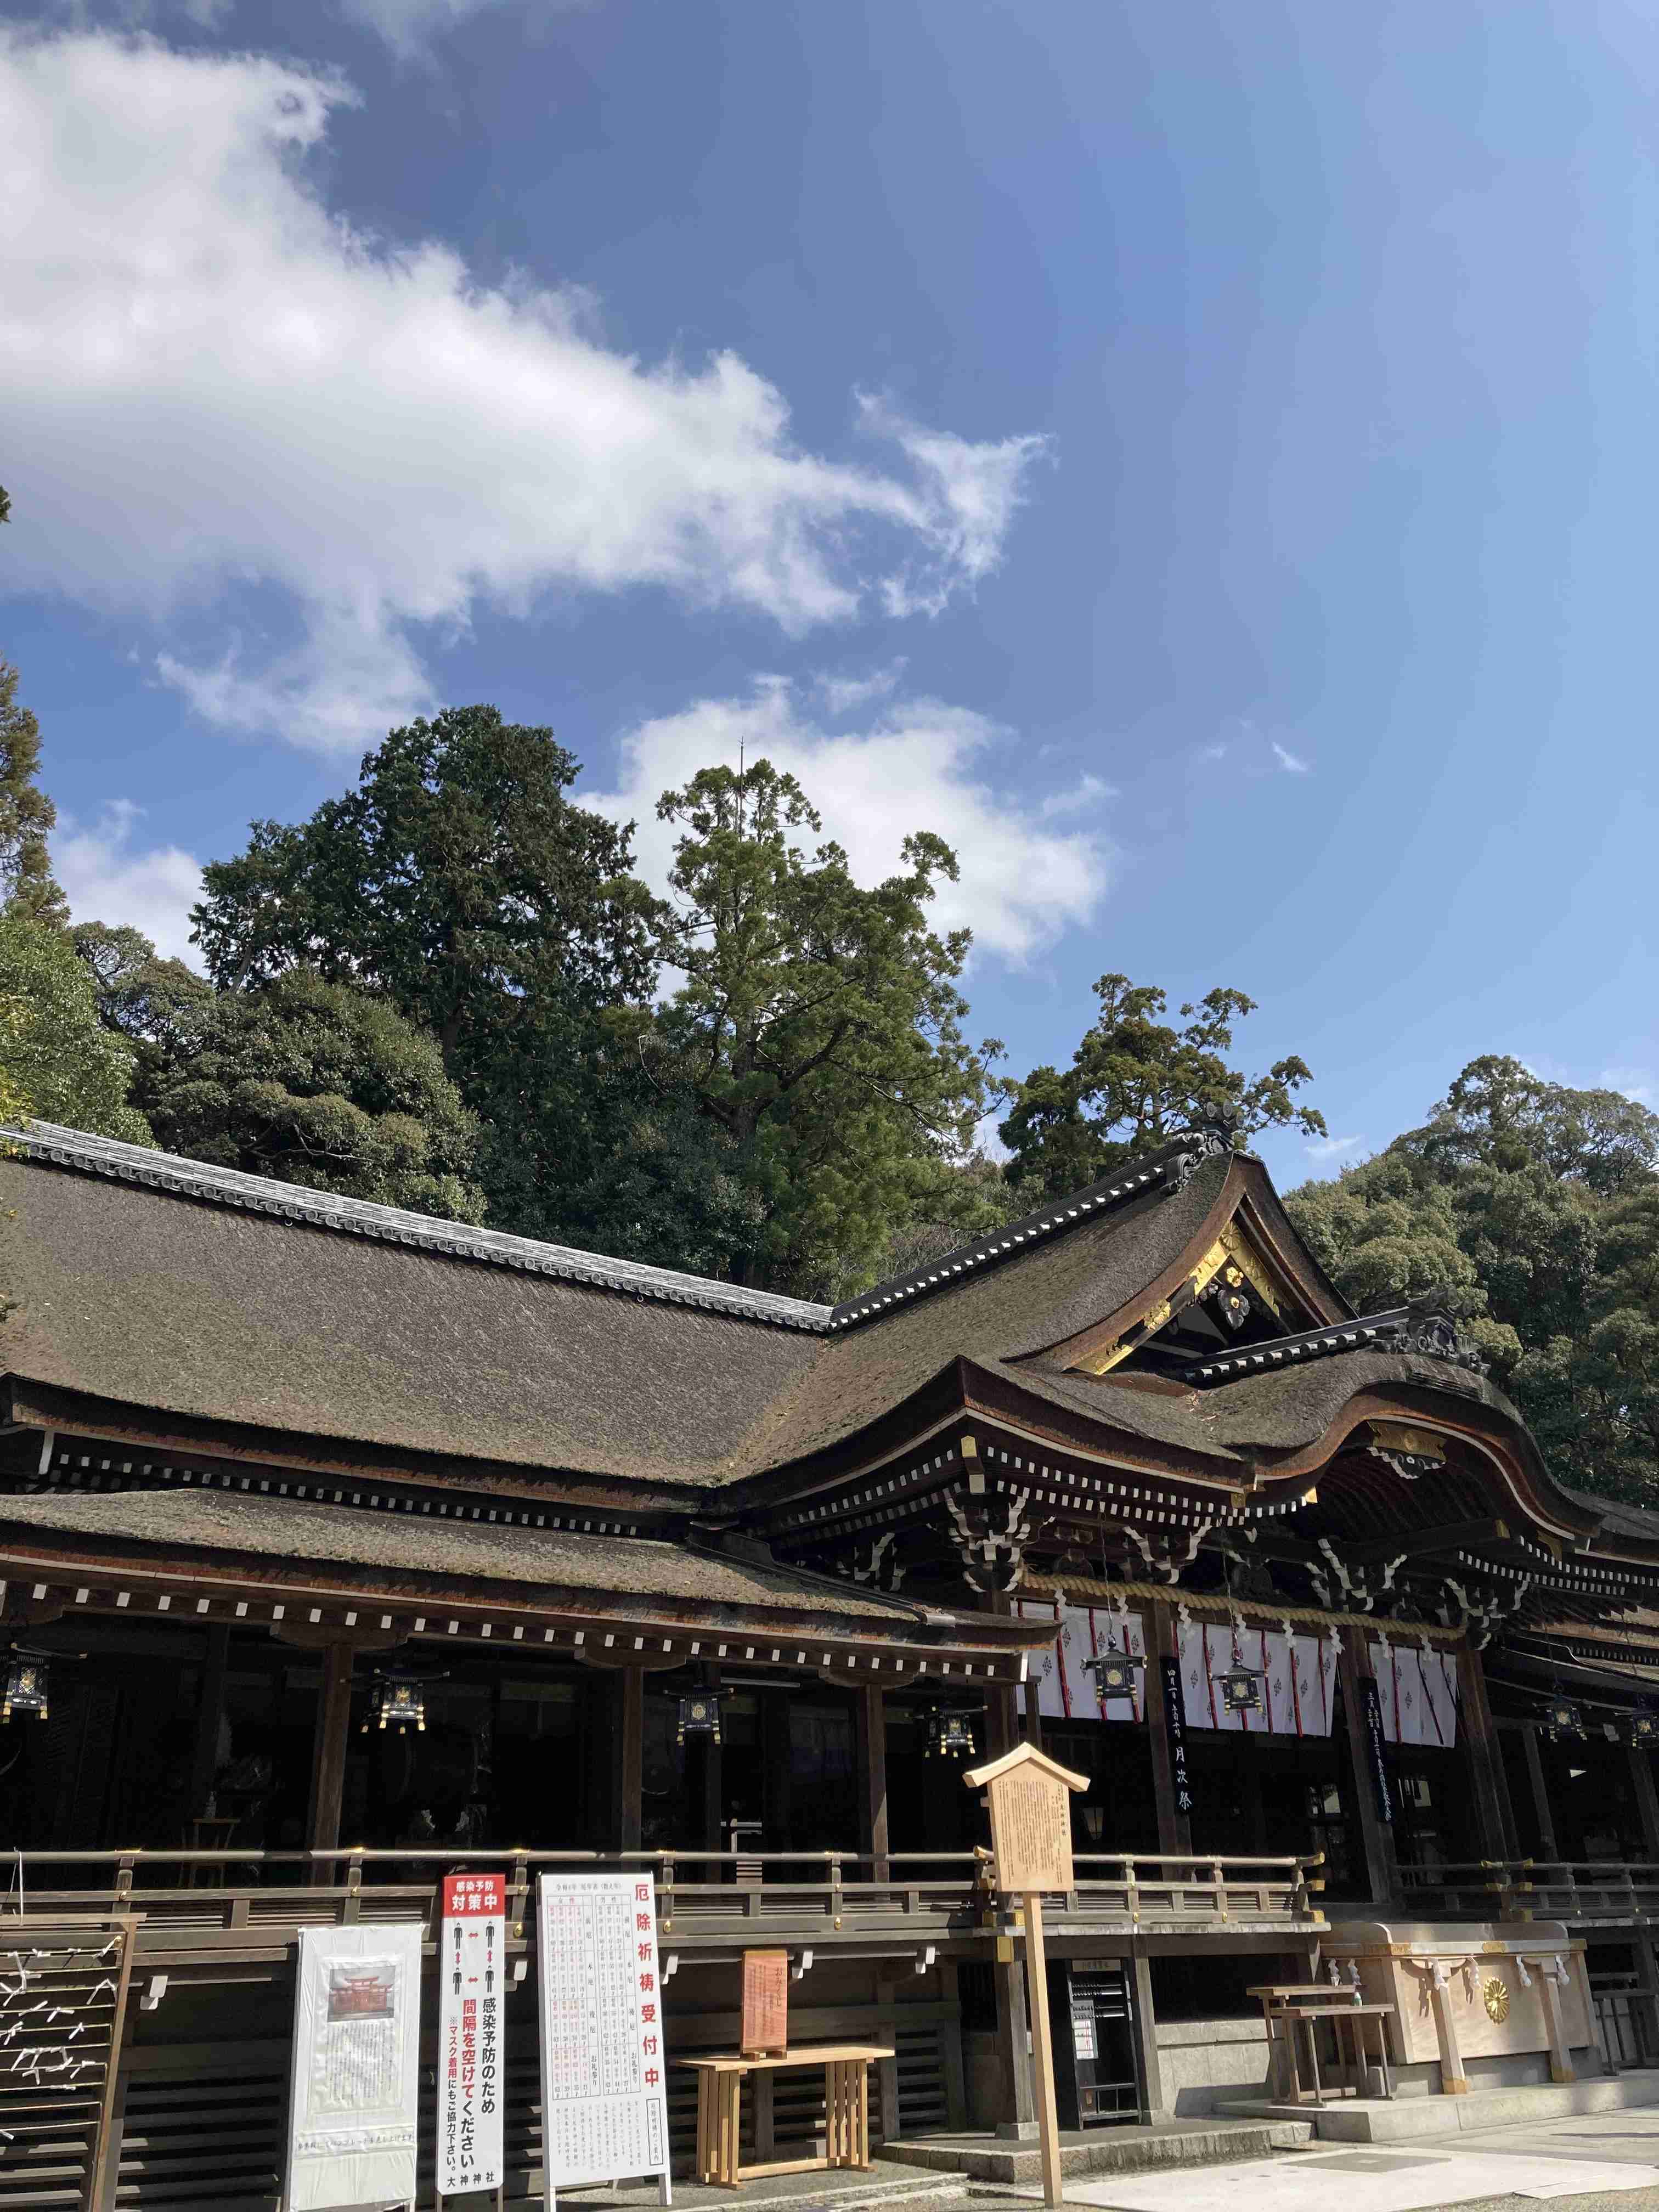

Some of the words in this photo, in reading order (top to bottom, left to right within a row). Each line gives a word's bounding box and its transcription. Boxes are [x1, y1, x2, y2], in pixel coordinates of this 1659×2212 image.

[1176, 1746, 1192, 1810] 月次祭
[452, 1893, 498, 1911] 対策中
[456, 1880, 494, 1892] 感染予防
[635, 1883, 658, 2088] 厄除祈祷受付中
[774, 1966, 783, 2007] おみくじ
[482, 1997, 496, 2114] 感染予防のため
[461, 1999, 477, 2169] 間隔を空けてください
[447, 2170, 495, 2188] 大神神社
